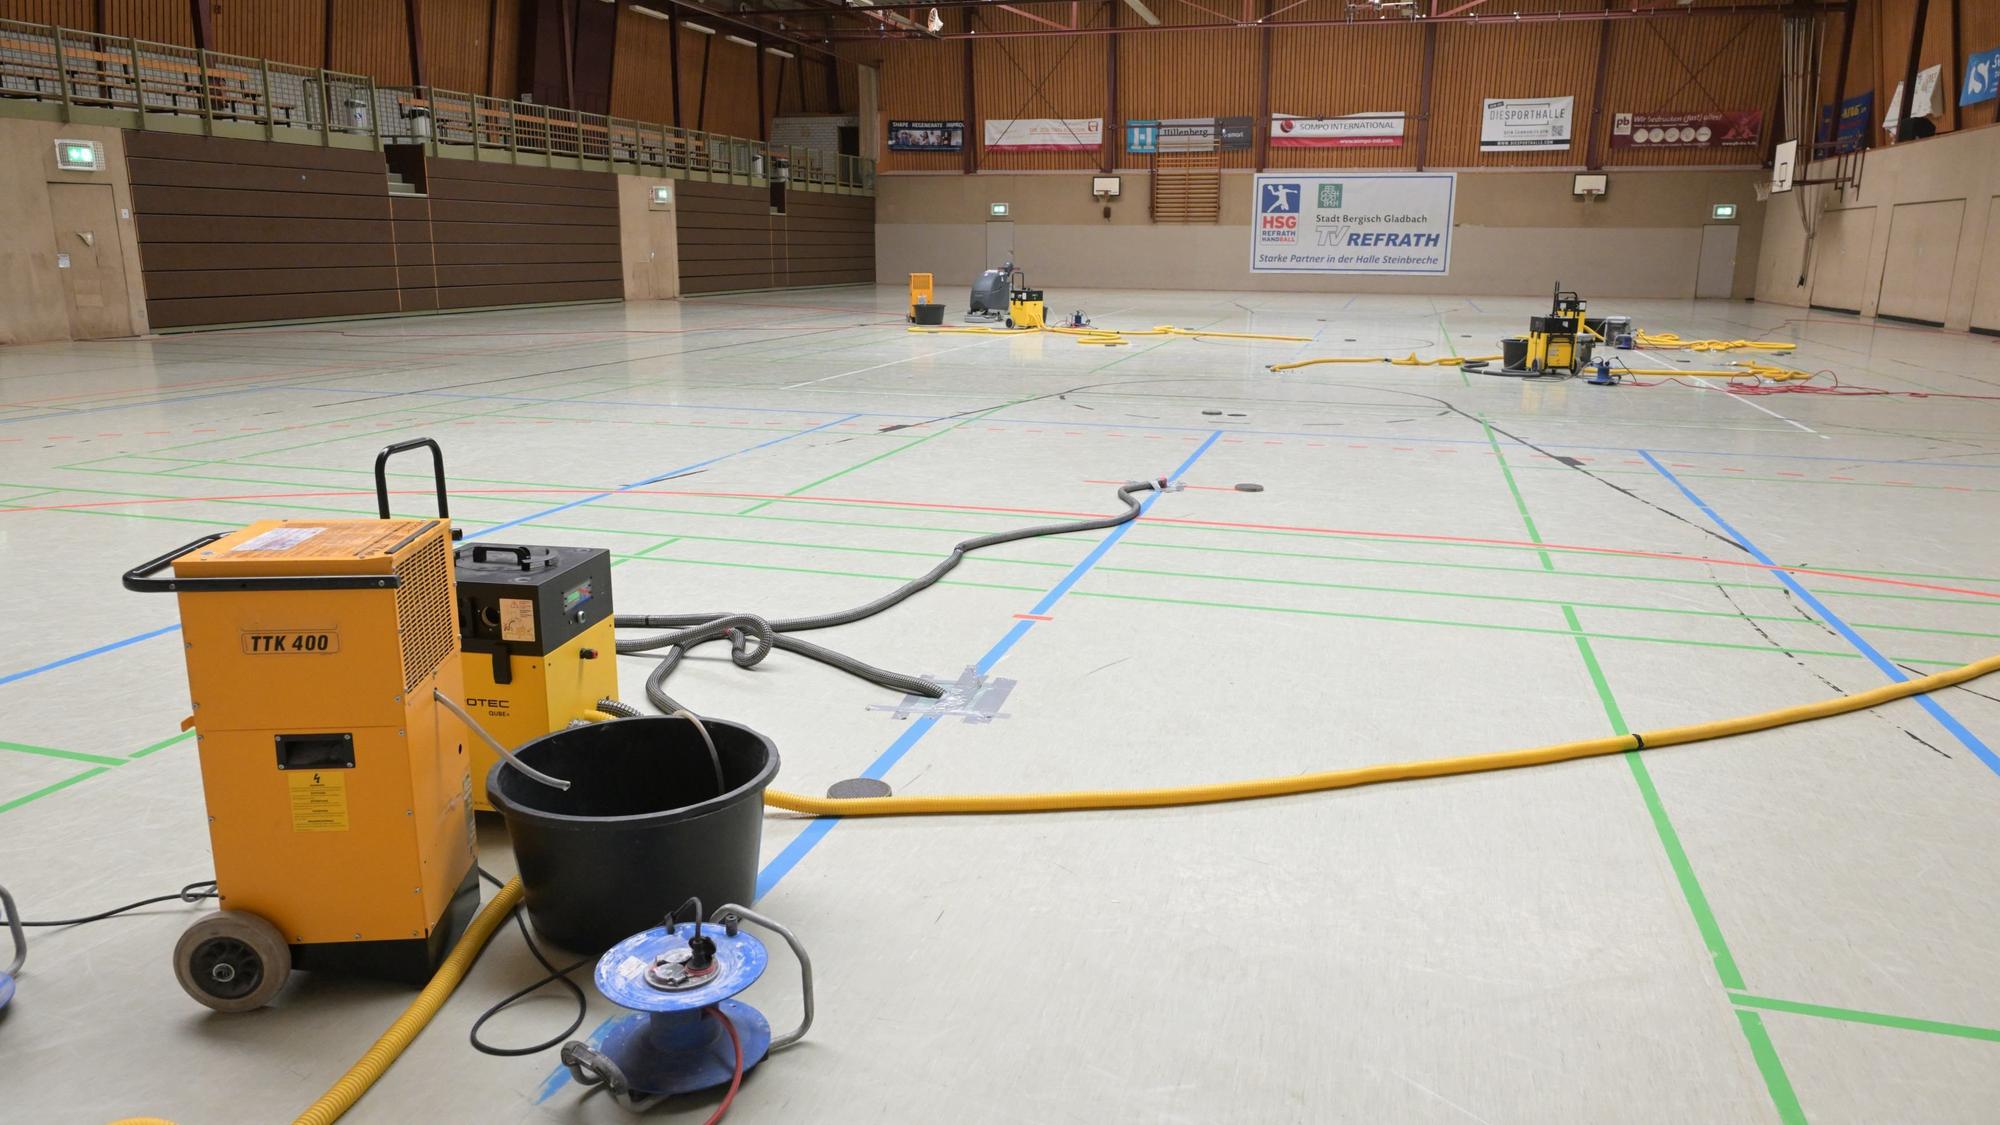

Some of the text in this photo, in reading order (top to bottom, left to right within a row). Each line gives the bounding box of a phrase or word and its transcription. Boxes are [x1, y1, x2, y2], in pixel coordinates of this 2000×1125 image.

[1489, 108, 1565, 120] DIESPORTHALLE
[1331, 121, 1394, 130] INTERNATIONAL
[1616, 116, 1630, 128] pb
[1164, 128, 1209, 137] Hillenberg
[1262, 215, 1297, 229] HSG
[1316, 214, 1428, 225] Stadt Bergisch Gladbach
[1315, 225, 1440, 248] TV REFRATH
[1259, 254, 1439, 265] Starke Partner in der Halle Steinbreche
[251, 634, 329, 652] TTK 400
